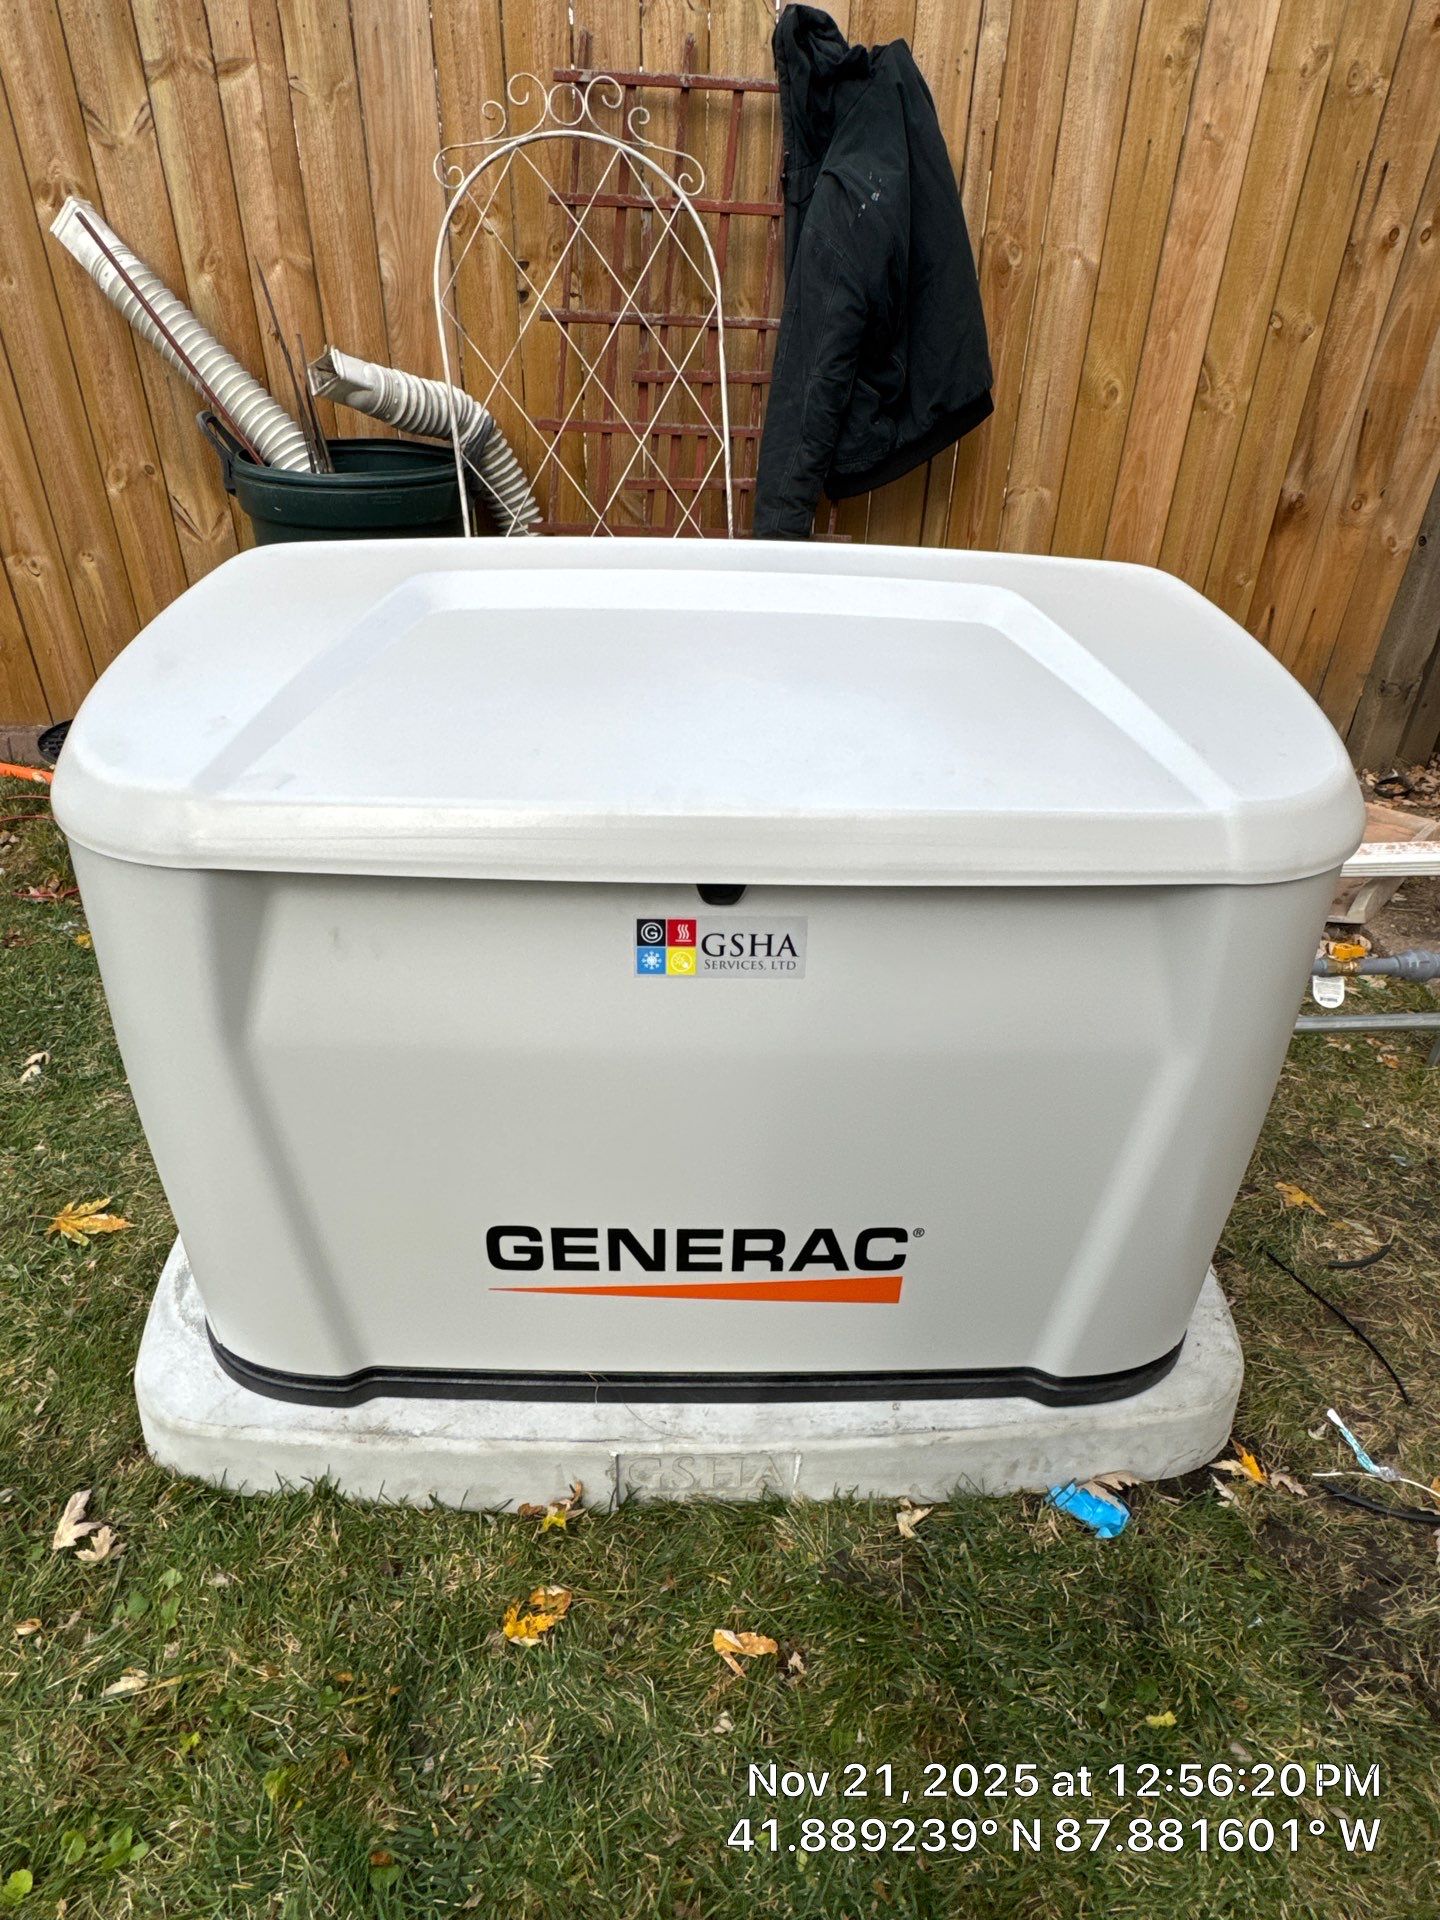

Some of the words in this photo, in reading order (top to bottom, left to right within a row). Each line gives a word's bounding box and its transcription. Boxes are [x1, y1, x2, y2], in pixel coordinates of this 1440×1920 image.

[701, 932, 799, 957] GSHA
[771, 960, 797, 971] LTD
[627, 1455, 784, 1489] GSHA
